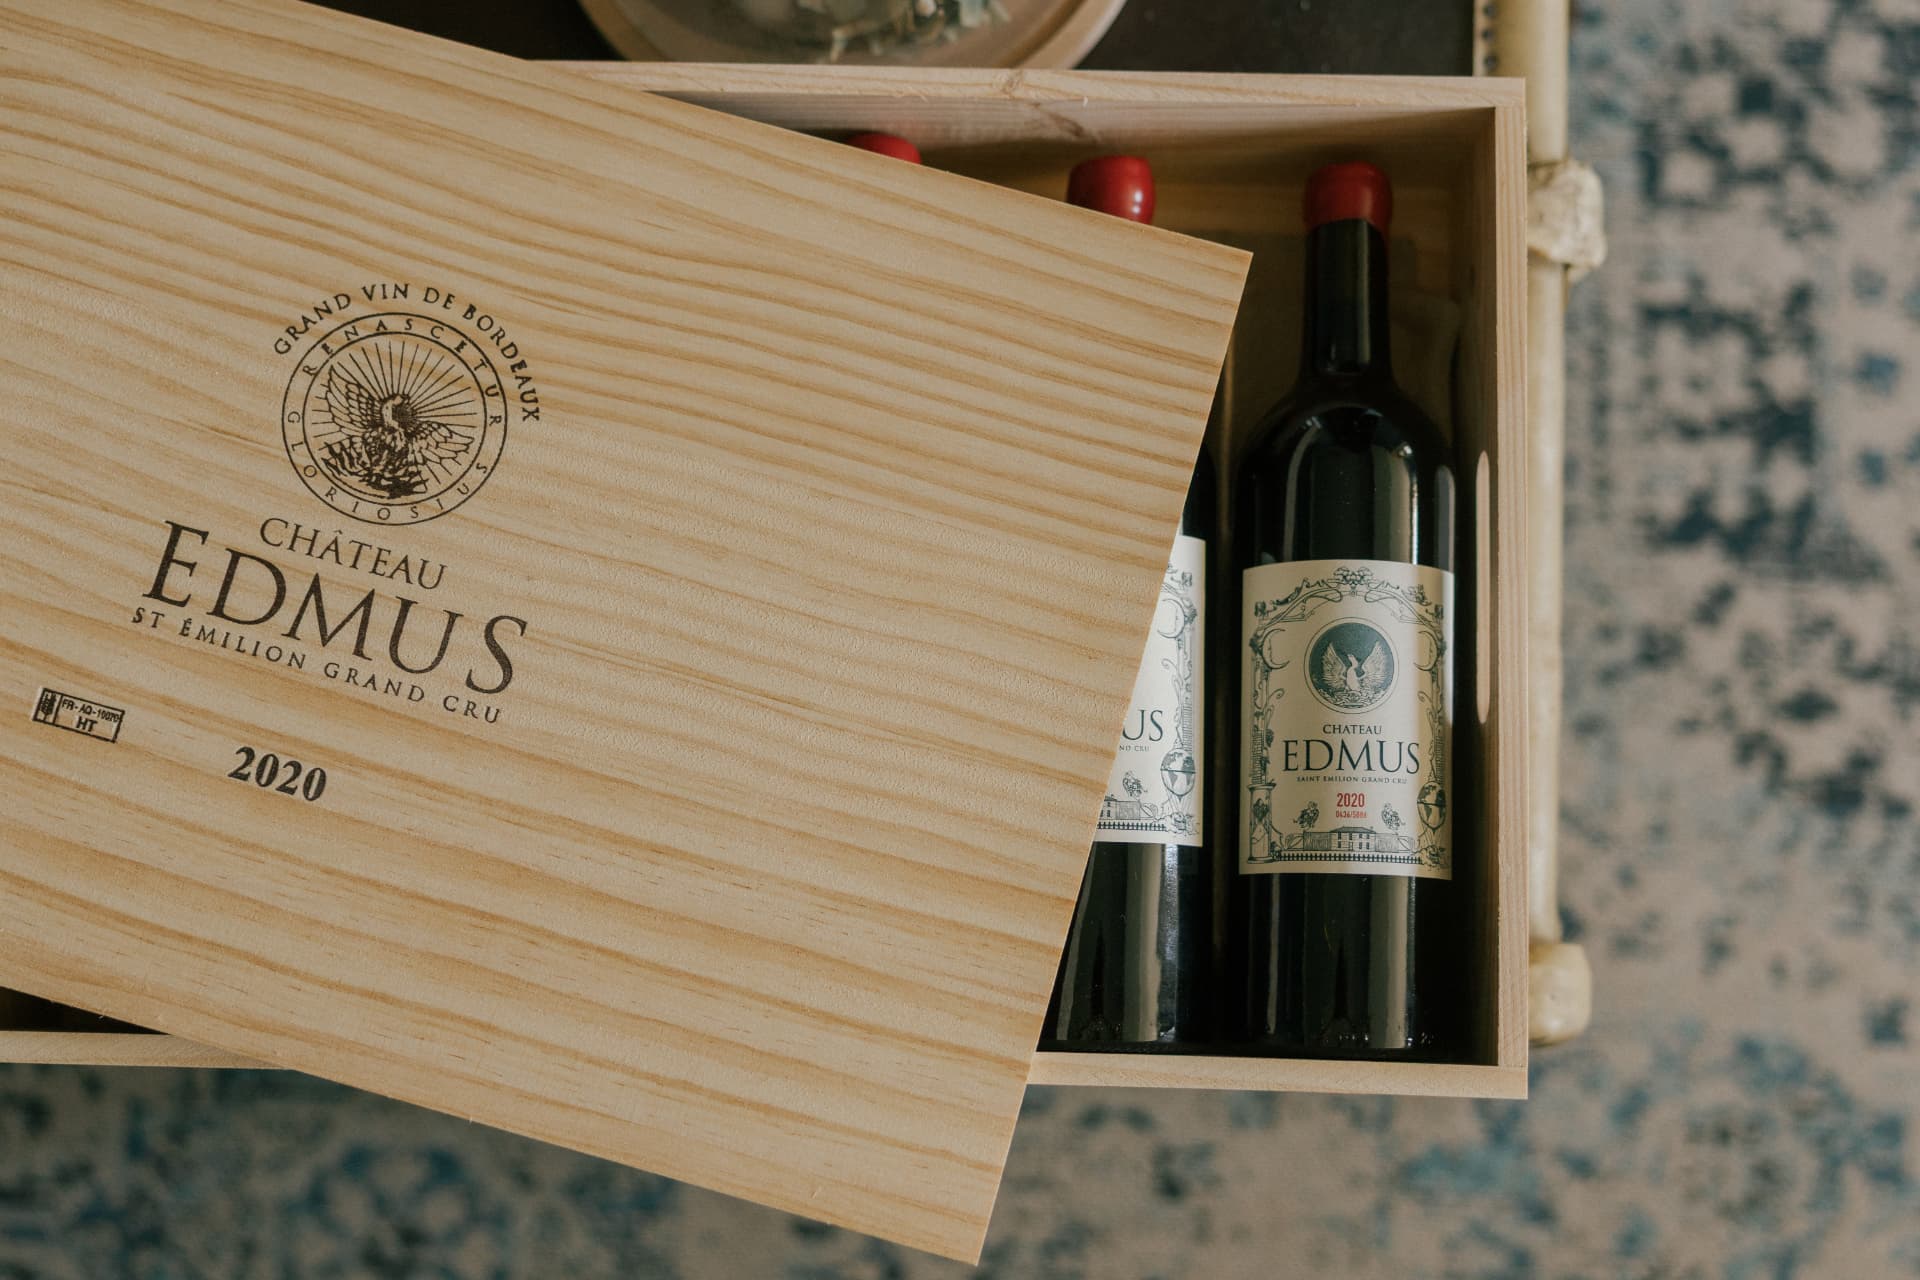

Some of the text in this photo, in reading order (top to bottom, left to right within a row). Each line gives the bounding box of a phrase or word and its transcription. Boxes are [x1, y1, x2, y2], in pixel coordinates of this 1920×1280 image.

[274, 283, 540, 422] GRAND VIN DE BORDEAUX
[302, 318, 502, 426] RENASCETUR
[287, 411, 488, 520] GLORIOSIUS
[259, 517, 448, 590] CHÂTEAU
[142, 520, 528, 695] EDMUS
[132, 607, 502, 723] ST ÉMILION GRAND CRU
[76, 716, 98, 732] HT
[1281, 738, 1420, 774] EDMUS
[1322, 724, 1382, 735] CHATEAU
[227, 746, 327, 802] 2020
[1296, 775, 1407, 785] SAINT EMILION GRAND CRU
[1336, 792, 1365, 808] 2020
